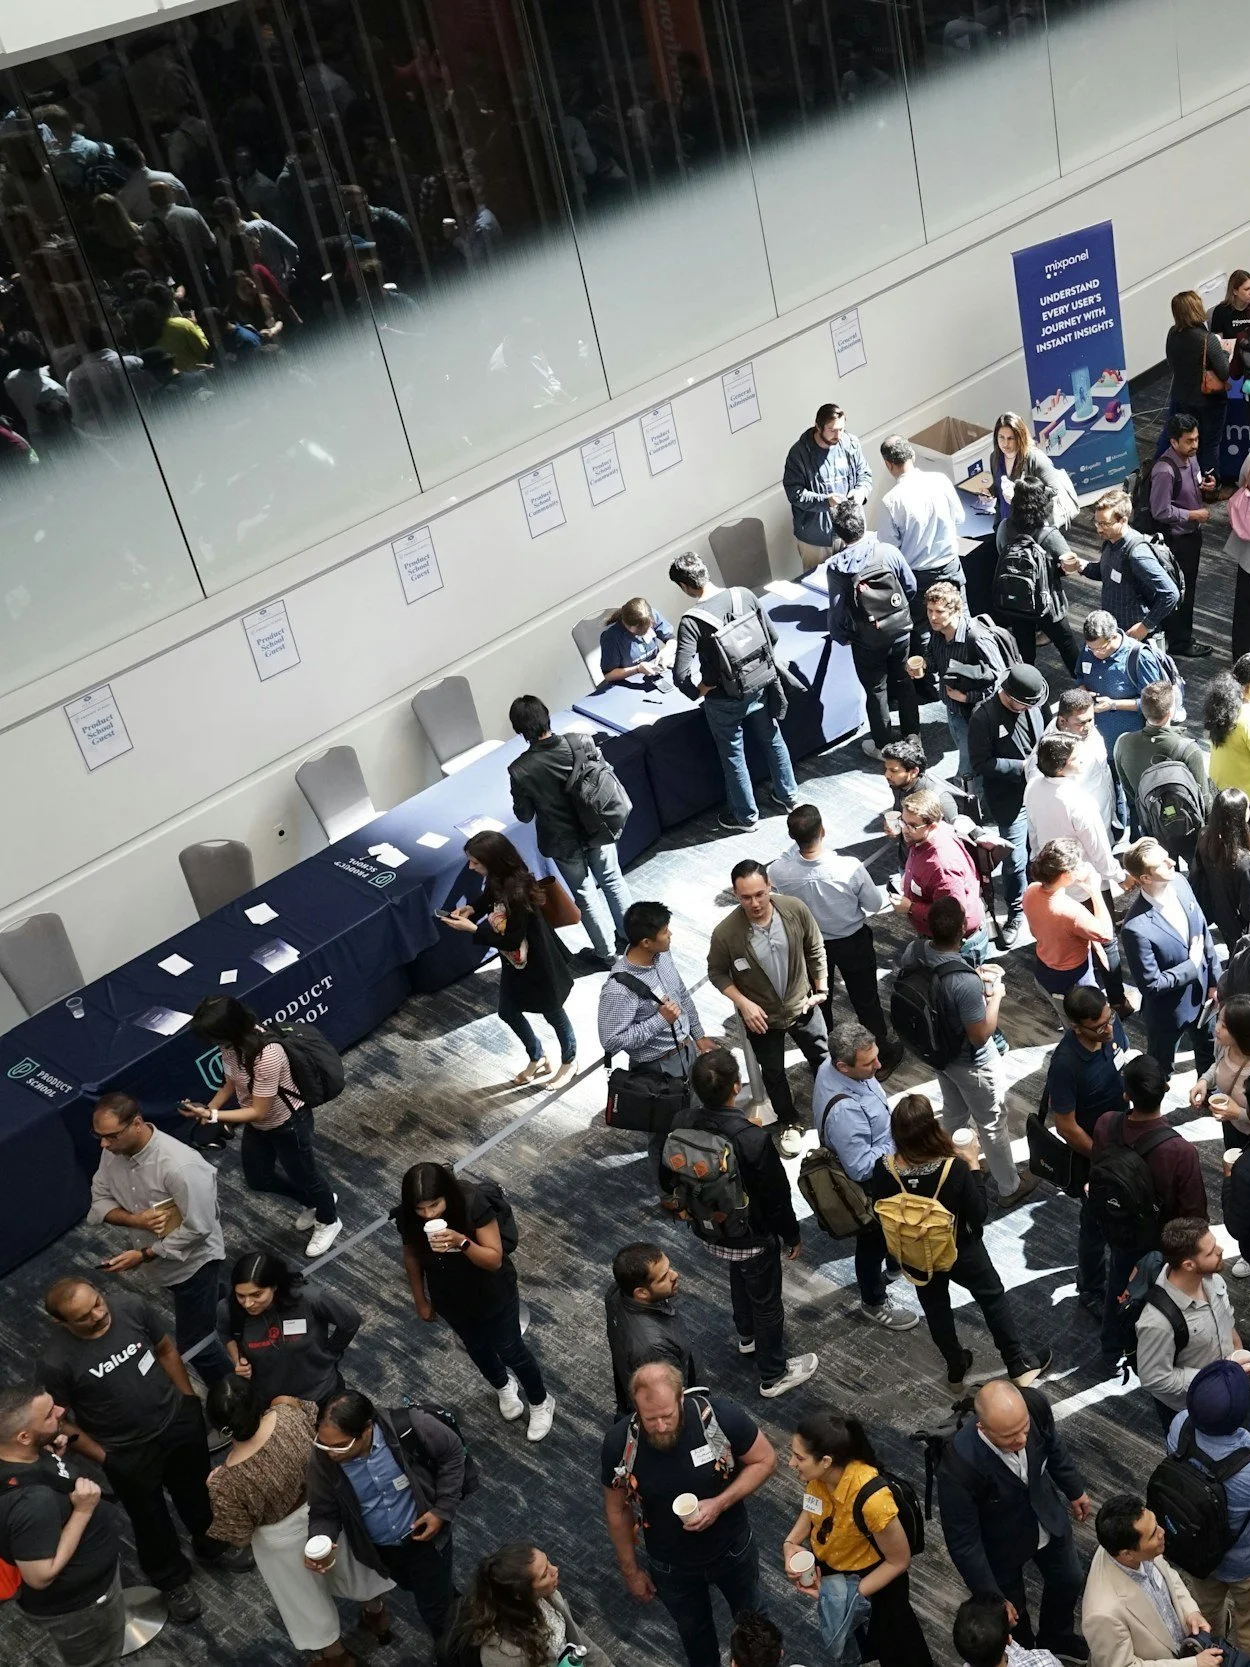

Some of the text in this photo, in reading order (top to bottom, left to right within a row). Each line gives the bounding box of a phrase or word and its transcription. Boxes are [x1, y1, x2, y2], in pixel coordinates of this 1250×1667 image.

[1045, 249, 1089, 273] mixpanel
[1040, 279, 1100, 306] UNDERSTAND
[1042, 293, 1102, 321] EVERY USER'S
[1041, 306, 1106, 337] JOURNEY WITH
[837, 332, 858, 346] General
[1036, 319, 1114, 353] INSTANT INSIGHTS
[837, 338, 862, 354] Admission
[729, 393, 756, 409] Admission
[730, 387, 751, 401] General
[651, 429, 670, 442] Product
[653, 435, 671, 447] School
[649, 438, 677, 456] Community
[592, 459, 612, 472] Product
[594, 464, 612, 476] School
[590, 468, 619, 486] Community
[530, 490, 552, 505] Product
[533, 496, 551, 509] School
[528, 499, 560, 518] Community
[404, 554, 430, 570] Product
[407, 561, 430, 575] School
[410, 569, 430, 581] Guest
[256, 628, 285, 645] Product
[261, 636, 285, 651] School
[264, 644, 286, 657] Guest
[82, 714, 113, 734] Product
[87, 722, 114, 740] School
[91, 730, 115, 745] Guest
[26, 1078, 57, 1097] SCHOOL
[36, 1070, 73, 1093] PRODUCT
[88, 1342, 142, 1378] Value.
